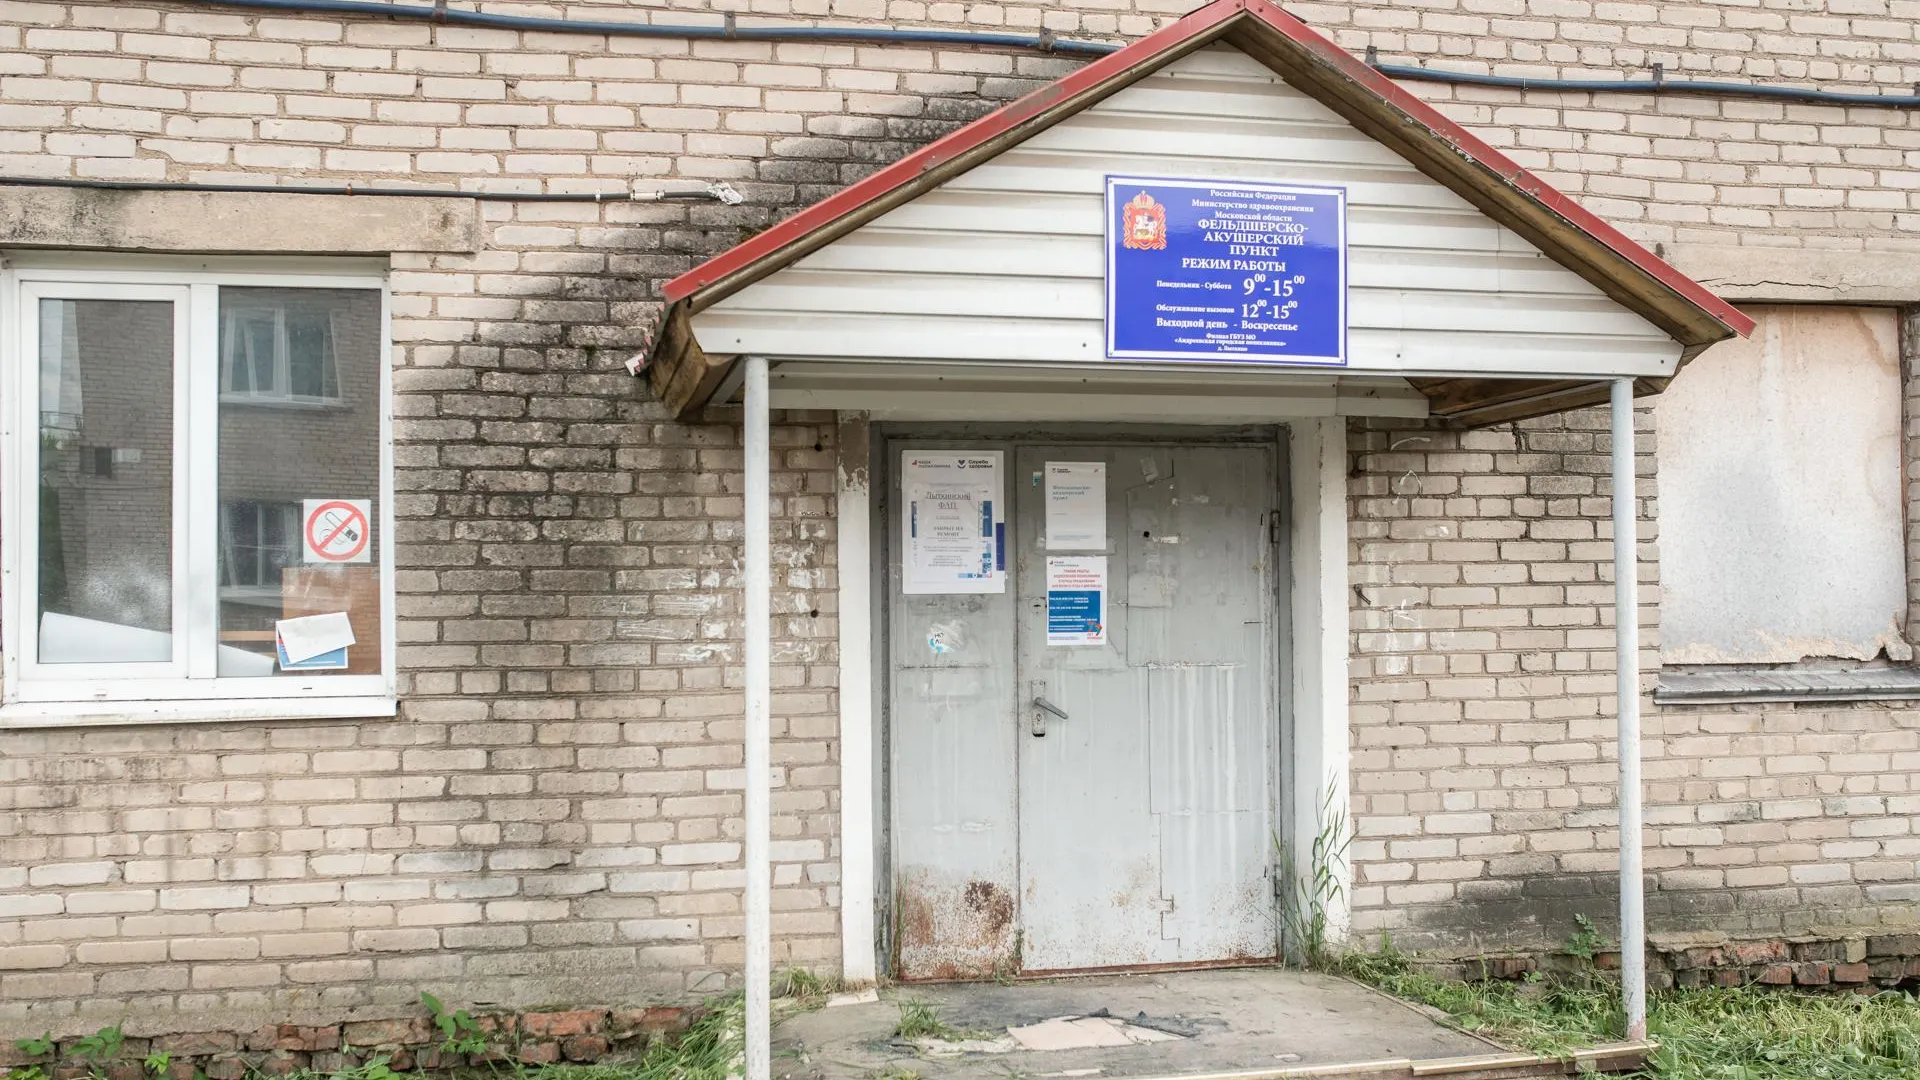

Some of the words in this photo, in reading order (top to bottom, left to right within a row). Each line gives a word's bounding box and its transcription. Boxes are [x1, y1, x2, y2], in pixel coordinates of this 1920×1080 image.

[1210, 189, 1253, 199] Российская
[1255, 191, 1297, 201] Федерация
[1192, 199, 1248, 210] Министерство
[1249, 202, 1314, 213] здравоохранения
[1214, 211, 1261, 220] Московской
[1262, 213, 1293, 222] области
[1198, 218, 1309, 234] ФЕЛЬДШЕРСКО-
[1203, 231, 1304, 246] АКУШЕРСКИЙ
[1229, 244, 1279, 257] ПУНКТ
[1182, 257, 1231, 270] РЕЖИМ
[1233, 260, 1287, 272] РАБОТЫ
[1156, 280, 1200, 289] Понедельник
[1204, 282, 1232, 291] Суббота
[1156, 304, 1206, 314] Обслуживание
[1206, 306, 1235, 314] вызовов
[1156, 317, 1204, 329] Выходной
[1205, 320, 1228, 329] день
[1241, 320, 1298, 332] Воскресенье
